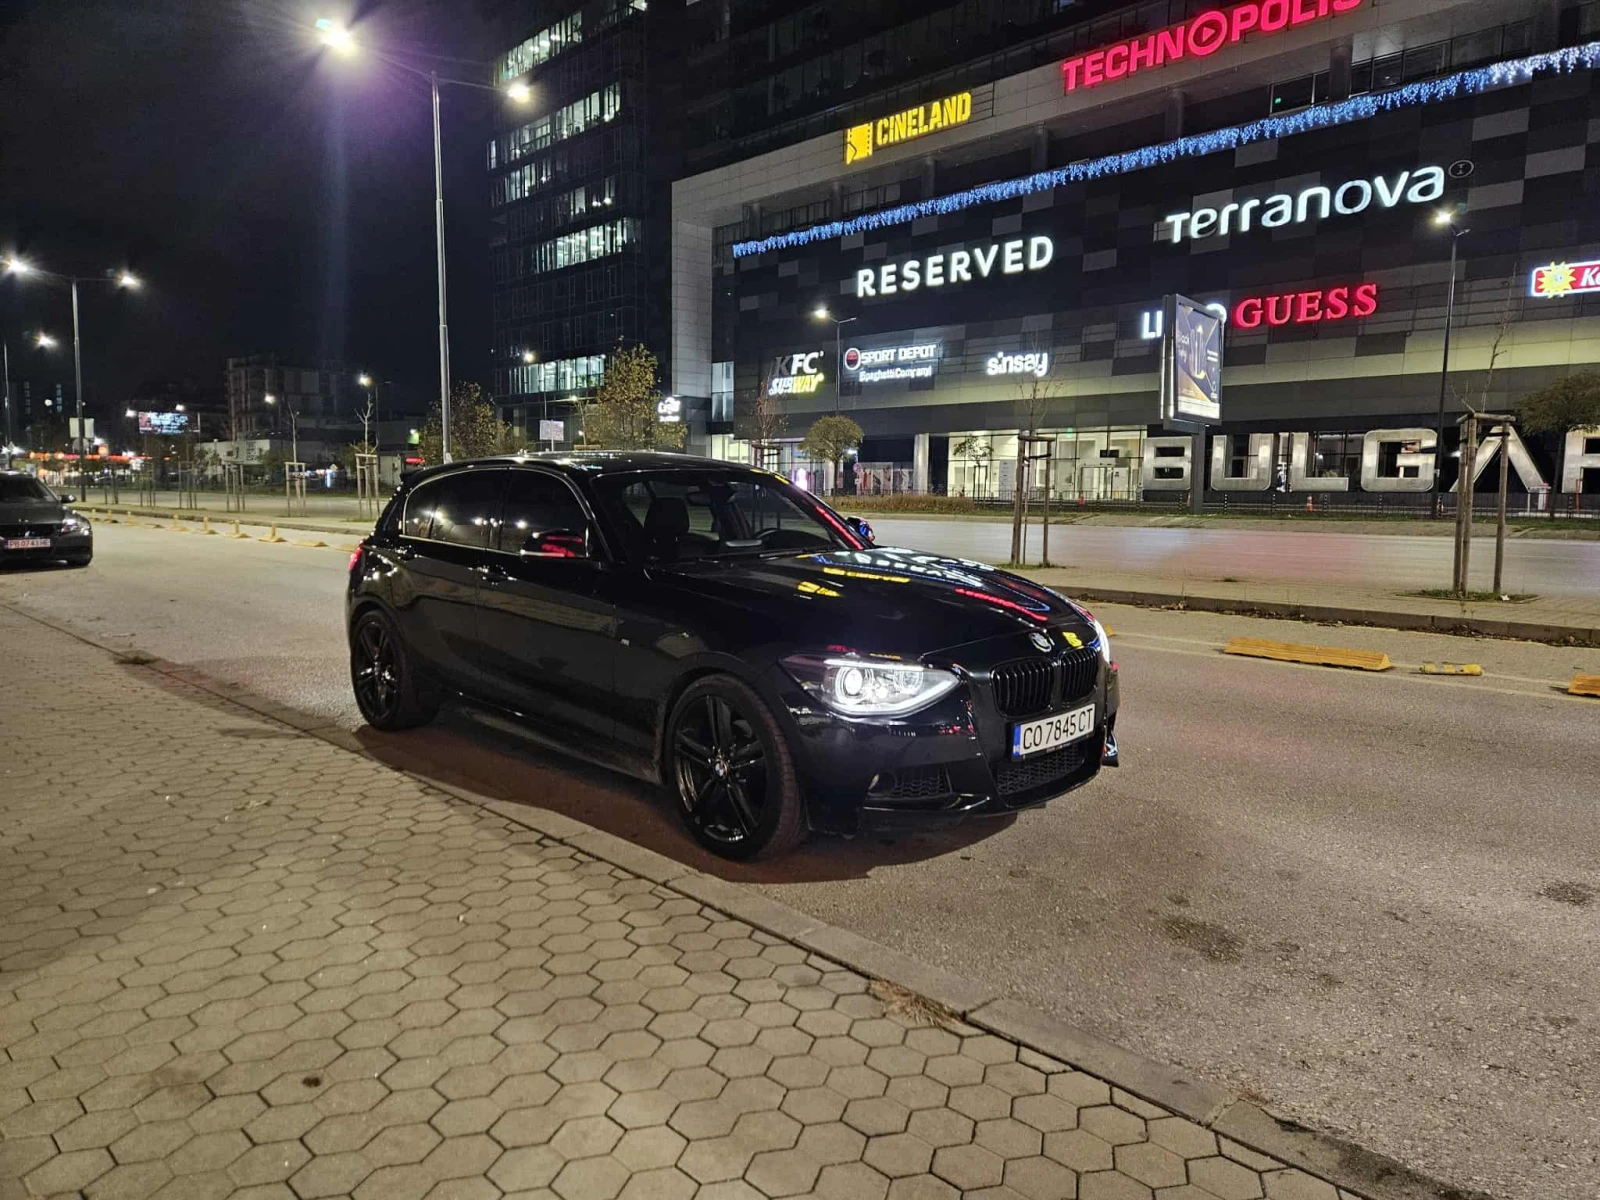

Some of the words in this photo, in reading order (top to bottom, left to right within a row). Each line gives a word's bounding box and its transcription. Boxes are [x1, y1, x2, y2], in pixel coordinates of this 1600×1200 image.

[876, 92, 972, 146] CINELAND
[1165, 165, 1445, 244] Terranova
[856, 235, 1054, 298] RESERVED
[1234, 283, 1378, 329] GUESS
[774, 351, 820, 376] KFC
[858, 349, 898, 365] SPORT
[903, 344, 938, 361] DEPOT
[987, 351, 1049, 378] sinsay
[768, 373, 824, 396] SUBWAY
